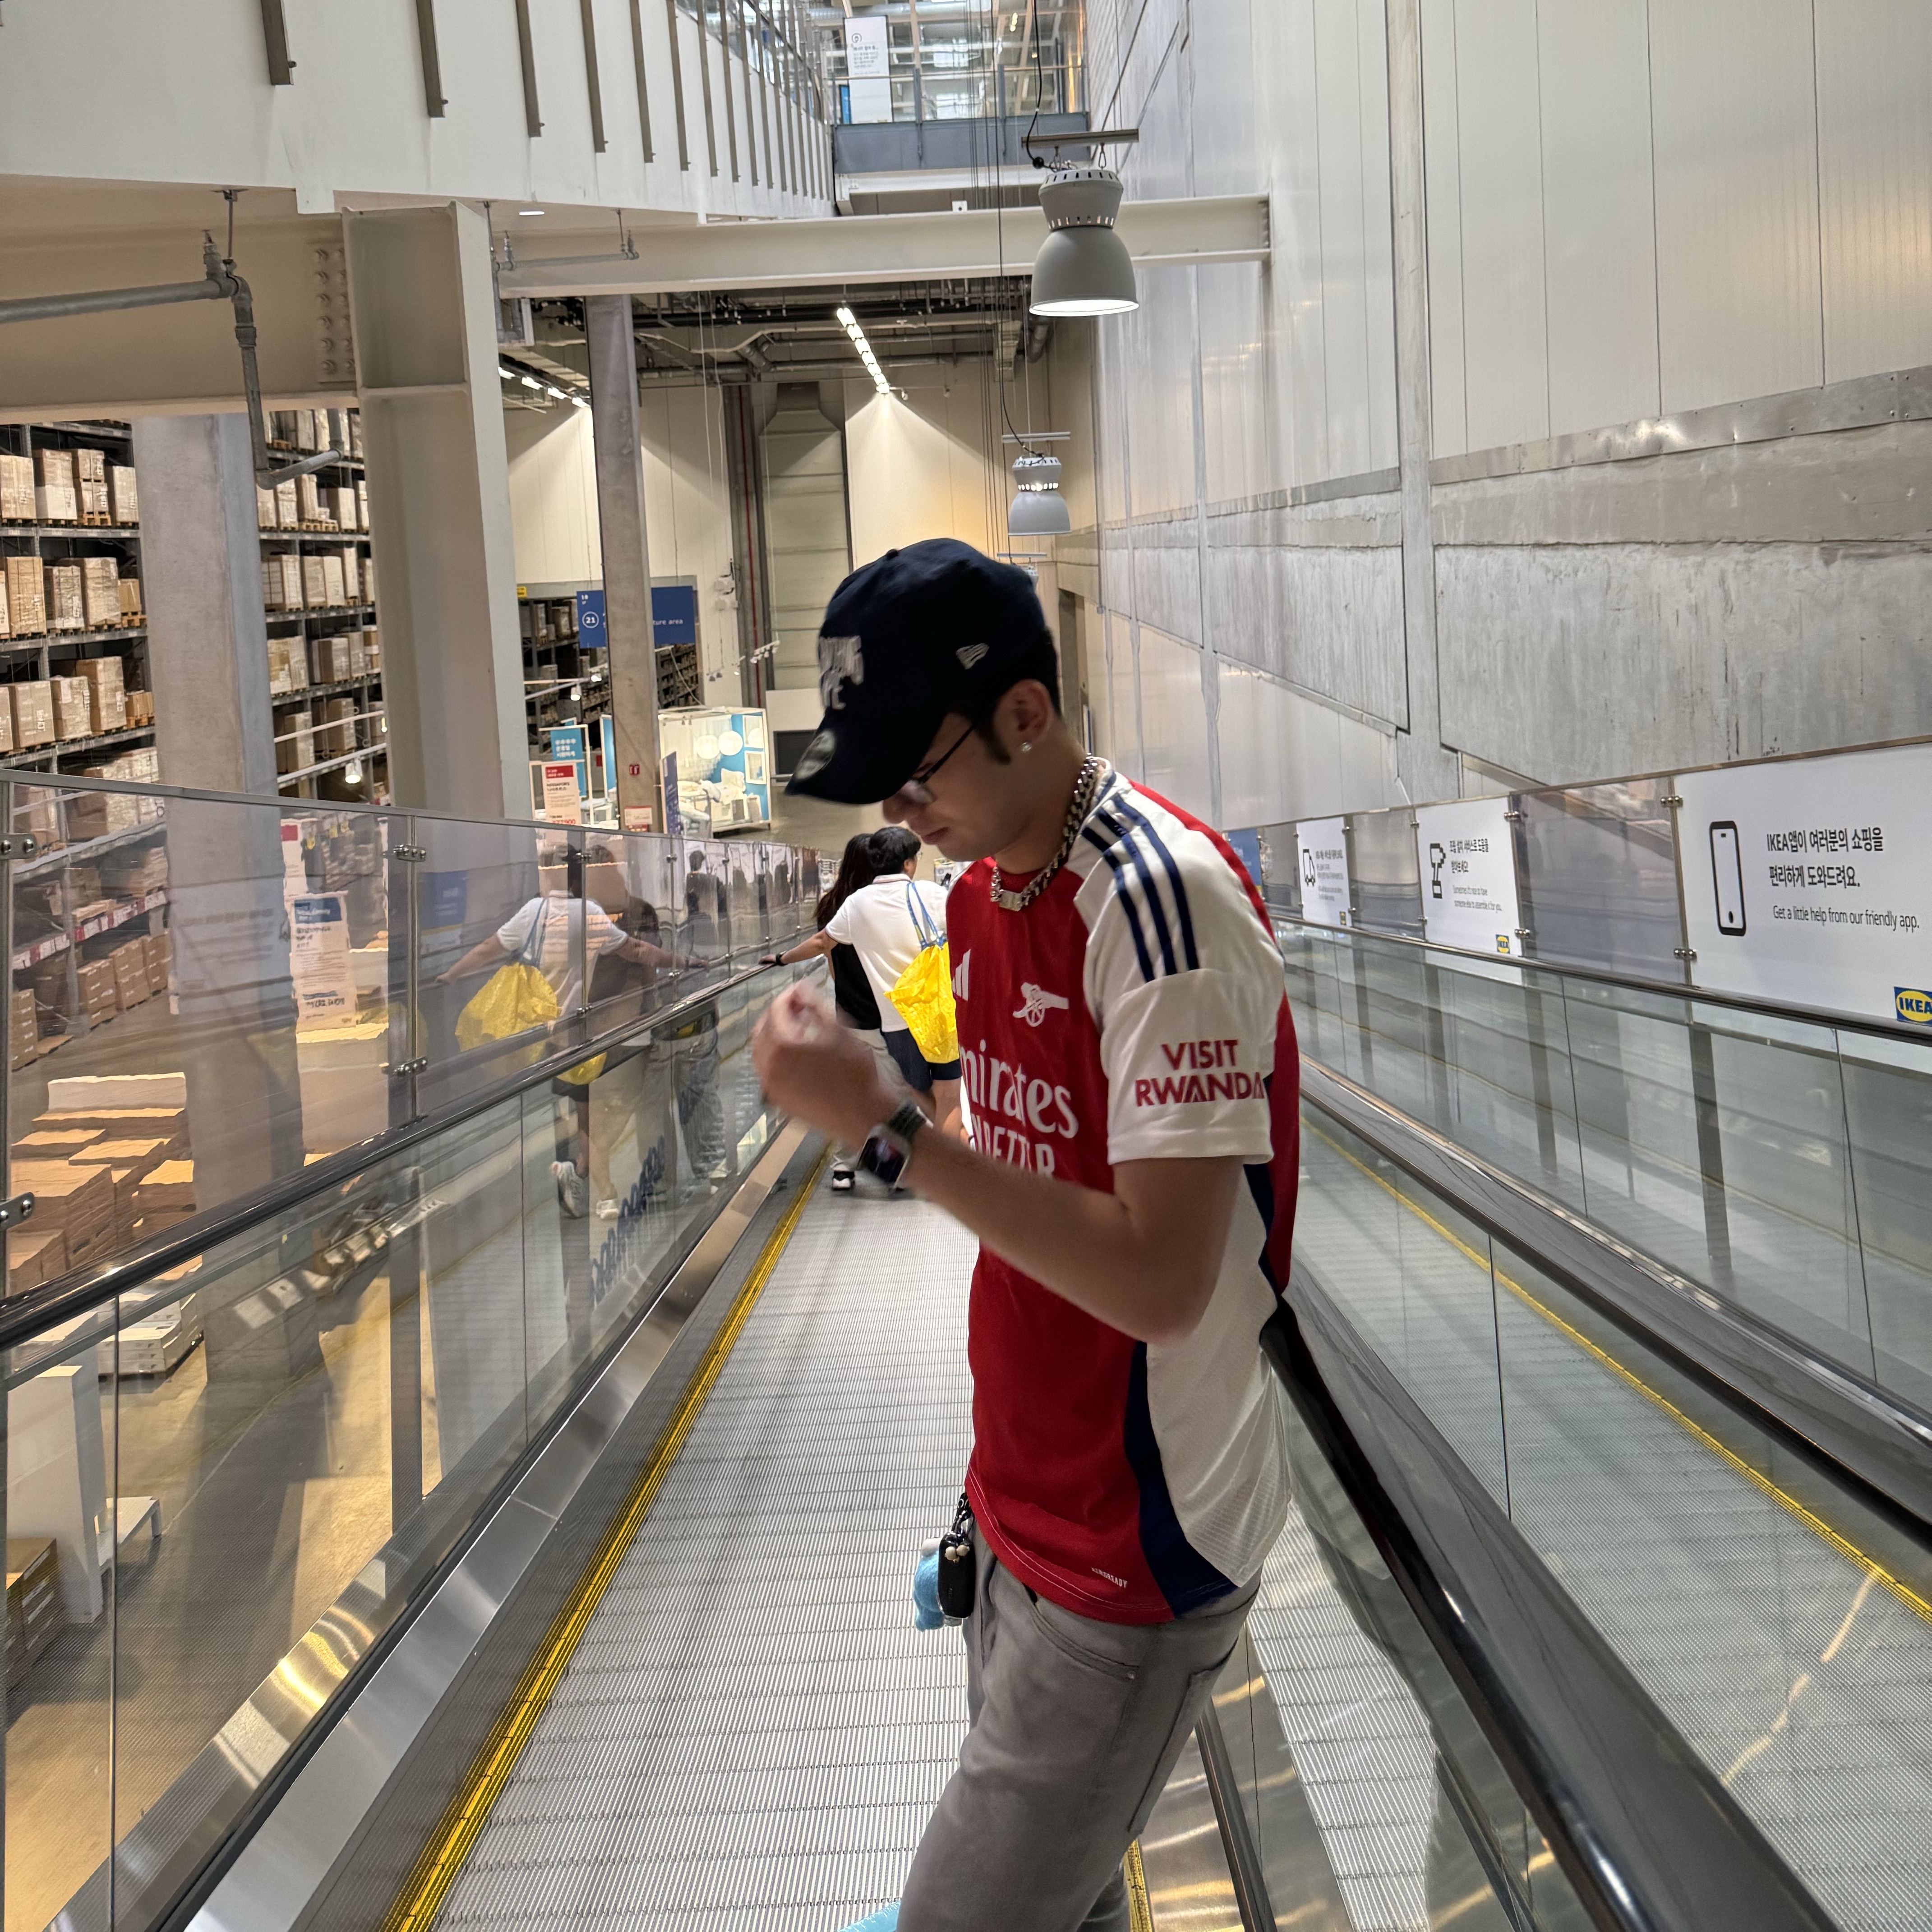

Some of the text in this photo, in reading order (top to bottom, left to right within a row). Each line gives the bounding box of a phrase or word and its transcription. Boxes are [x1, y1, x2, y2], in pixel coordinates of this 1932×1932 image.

[1767, 827, 1883, 853] IKEA앱이 여러분의 쇼핑을
[1769, 865, 1860, 888] 편리하게 도와드려요.
[1773, 905, 1919, 933] Get a little help from our friendly app.
[1899, 997, 1932, 1014] IKEA
[1161, 1039, 1238, 1071] VISIT
[959, 1039, 1079, 1139] mirates
[1135, 1072, 1265, 1107] RWANDA
